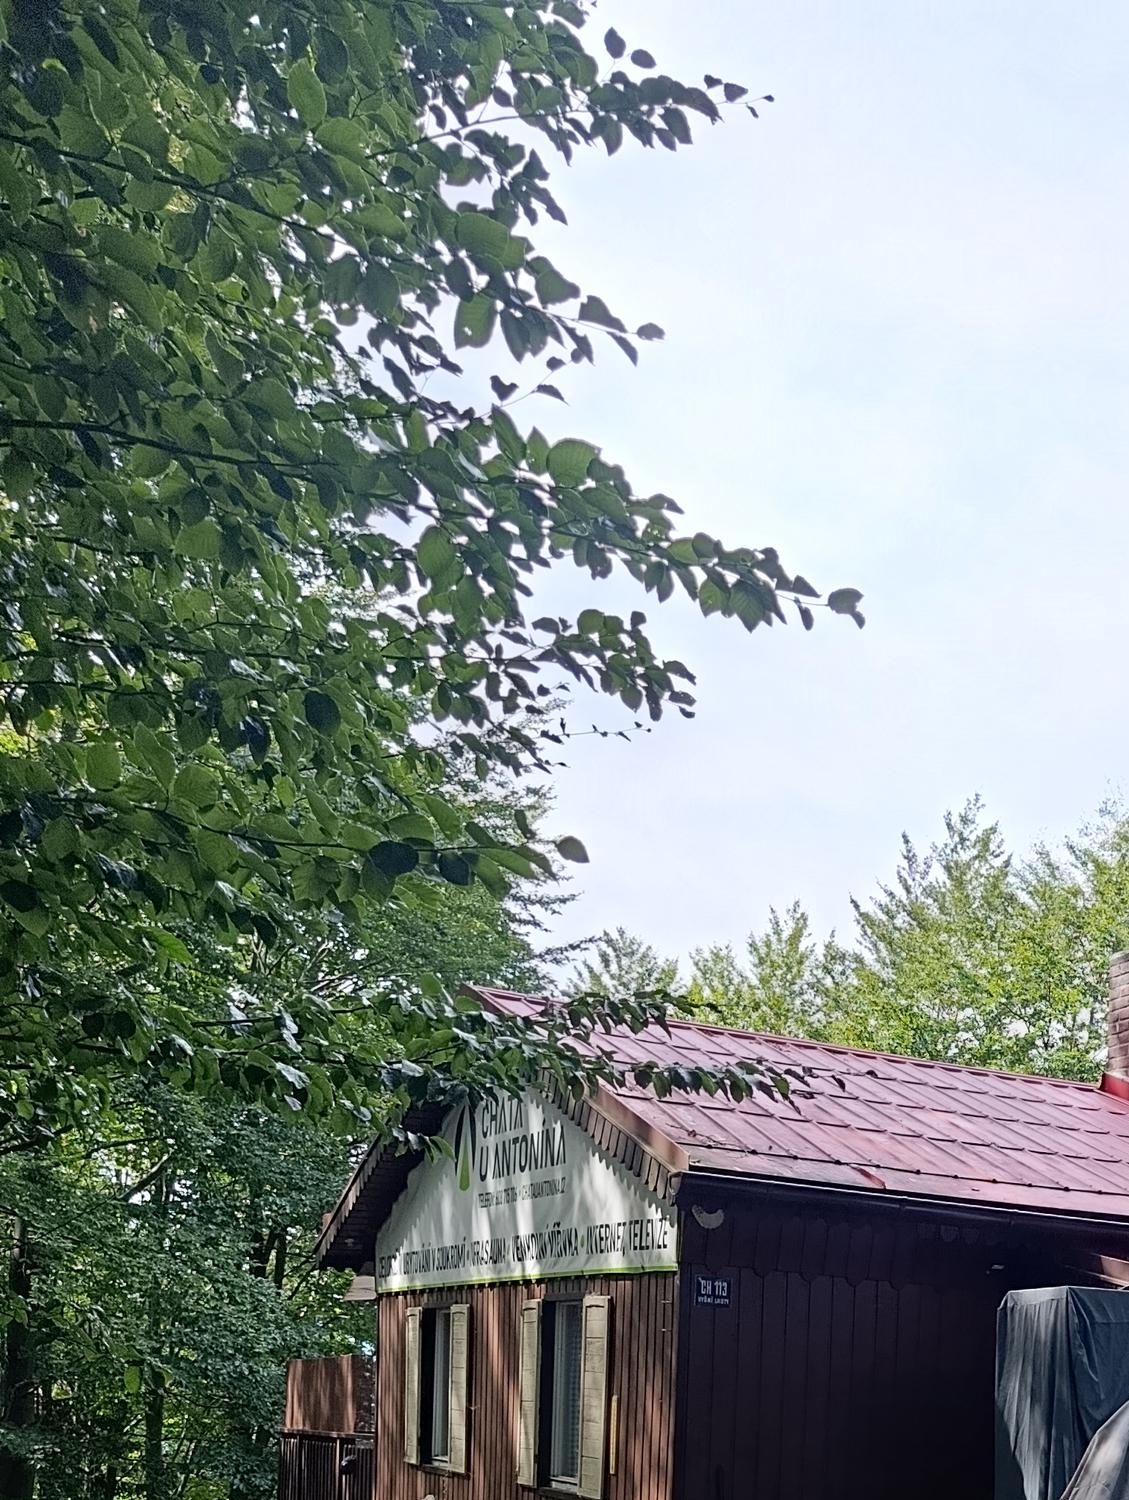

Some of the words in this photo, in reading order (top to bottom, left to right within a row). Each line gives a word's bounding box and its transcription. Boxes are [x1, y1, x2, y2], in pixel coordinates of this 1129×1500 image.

[479, 1146, 488, 1182] U
[492, 1117, 566, 1180] ANTONÍNA
[700, 1280, 712, 1295] CH
[714, 1281, 728, 1297] 113
